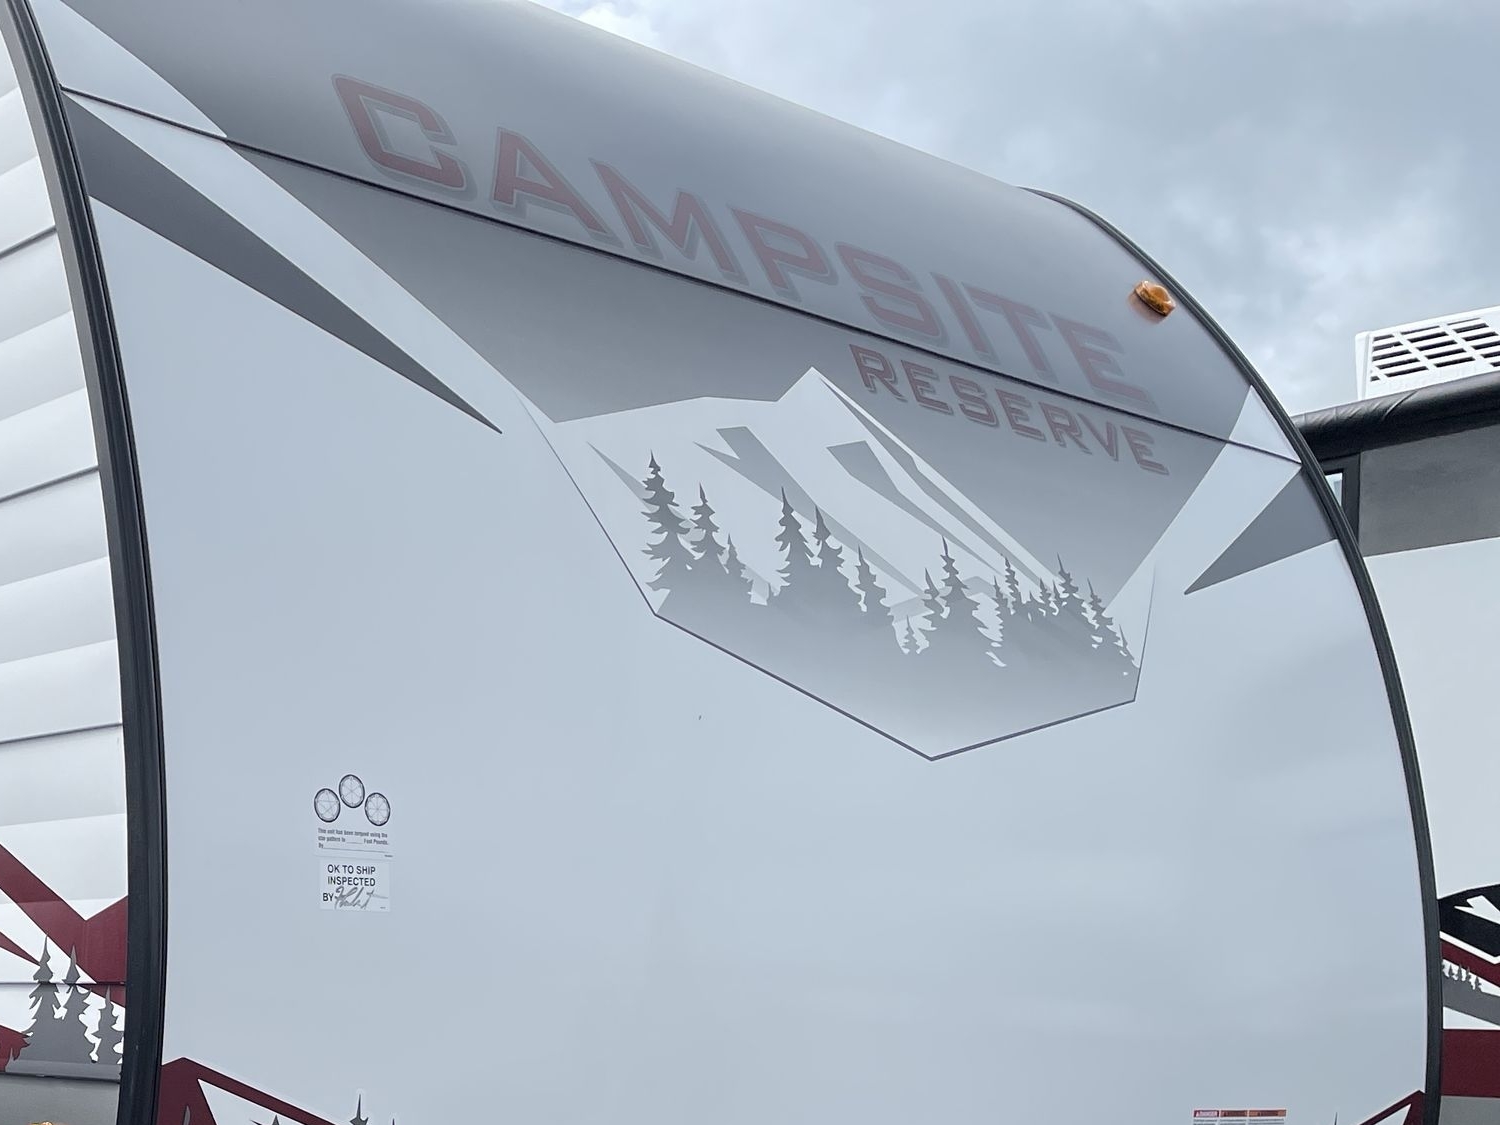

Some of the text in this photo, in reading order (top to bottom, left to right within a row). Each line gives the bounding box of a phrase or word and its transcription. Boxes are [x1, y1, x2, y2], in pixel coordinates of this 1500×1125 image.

[331, 73, 1156, 408] CAMPSITE
[848, 343, 1169, 475] RESERVE
[327, 864, 376, 875] OK TO SHIP
[327, 876, 376, 886] INSPECTED
[323, 893, 334, 901] BY
